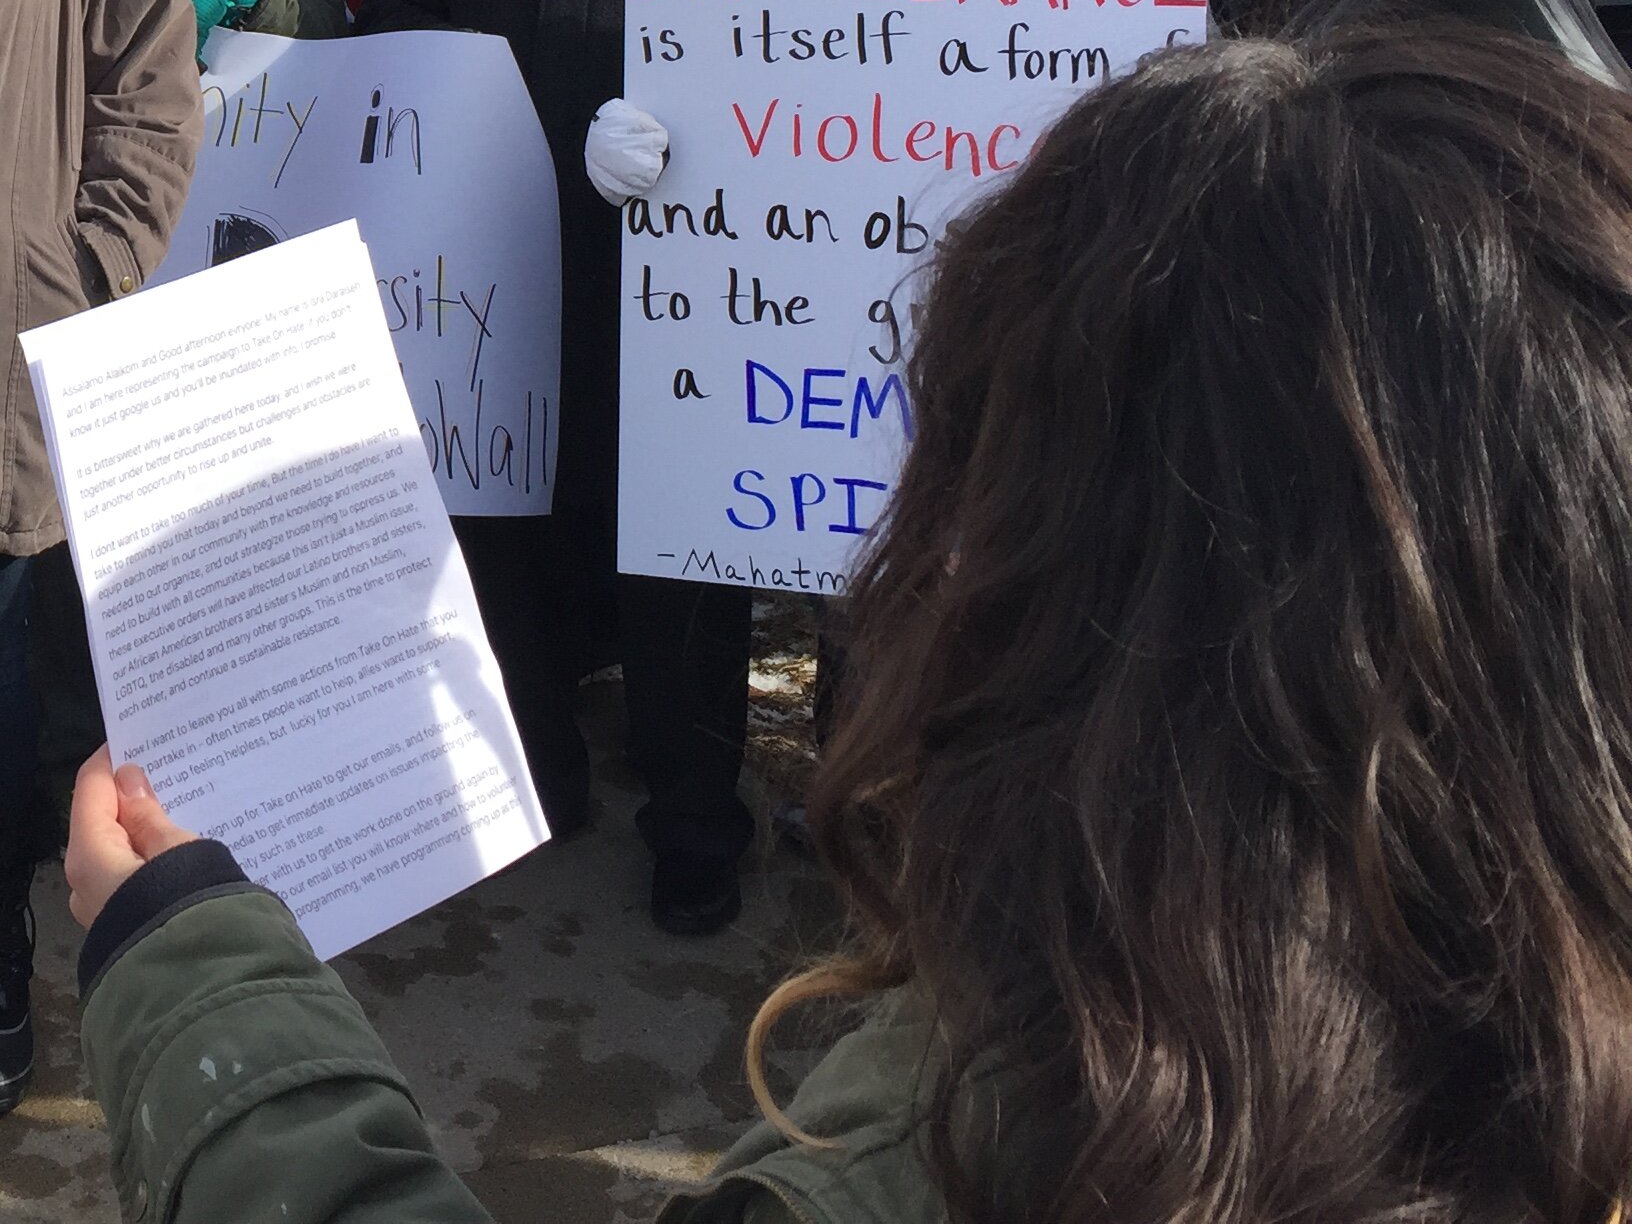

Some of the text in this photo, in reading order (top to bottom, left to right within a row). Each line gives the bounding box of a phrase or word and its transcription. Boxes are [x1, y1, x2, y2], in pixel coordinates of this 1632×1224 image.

[640, 25, 684, 64] is
[732, 10, 910, 65] itself
[940, 39, 989, 76] a
[998, 22, 1110, 82] form
[360, 83, 422, 176] in
[732, 92, 1048, 177] Violenc
[628, 188, 738, 240] and
[767, 204, 838, 244] an
[634, 265, 815, 326] to the
[674, 360, 915, 442] a DEM
[122, 741, 146, 762] Now
[150, 727, 176, 750] want
[175, 722, 189, 738] to
[187, 710, 216, 733] leave
[216, 704, 236, 723] you
[235, 696, 249, 712] all
[248, 686, 271, 707] with
[271, 676, 298, 697] some
[298, 658, 334, 684] actions
[334, 647, 358, 669] from
[357, 637, 381, 658] Take
[381, 630, 397, 648] On
[396, 620, 419, 641] Hate
[439, 606, 458, 624] you
